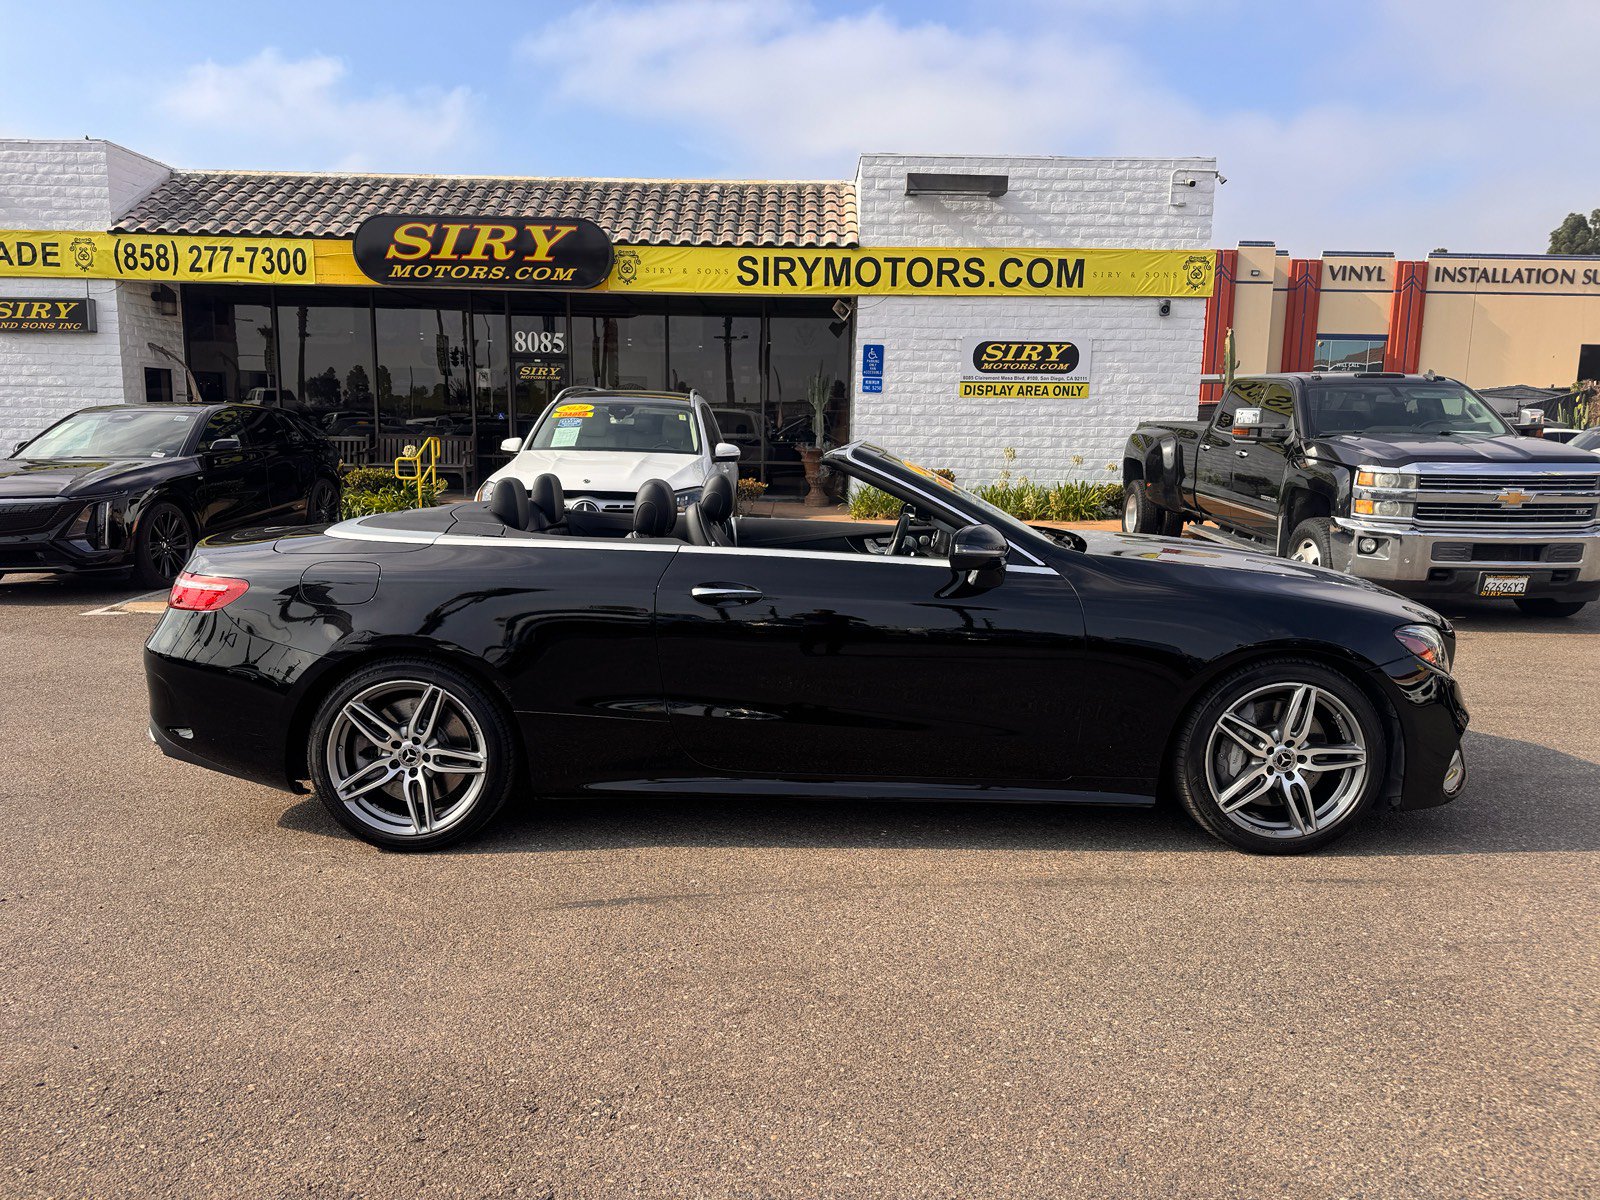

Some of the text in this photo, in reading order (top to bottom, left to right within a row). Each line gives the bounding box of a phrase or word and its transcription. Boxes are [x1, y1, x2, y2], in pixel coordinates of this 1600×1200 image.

[385, 222, 578, 263] SIRY
[113, 238, 307, 276] (858) 277-7300
[388, 264, 577, 281] MOTORS.COM
[682, 267, 688, 275] &
[736, 255, 1085, 288] SIRYMOTORS.COM
[1092, 271, 1178, 279] SIRY & SONS
[1328, 265, 1386, 282] VINYL
[1434, 266, 1576, 285] INSTALLATION
[0, 301, 79, 319] SIRY
[58, 322, 82, 330] INC
[514, 330, 565, 353] 8085
[981, 343, 1071, 361] SIRY
[519, 366, 561, 376] SIRY
[981, 362, 1070, 371] MOTORS.COM
[963, 384, 1084, 397] DISPLAY AREA ONLY
[1484, 582, 1526, 592] 62696Y3
